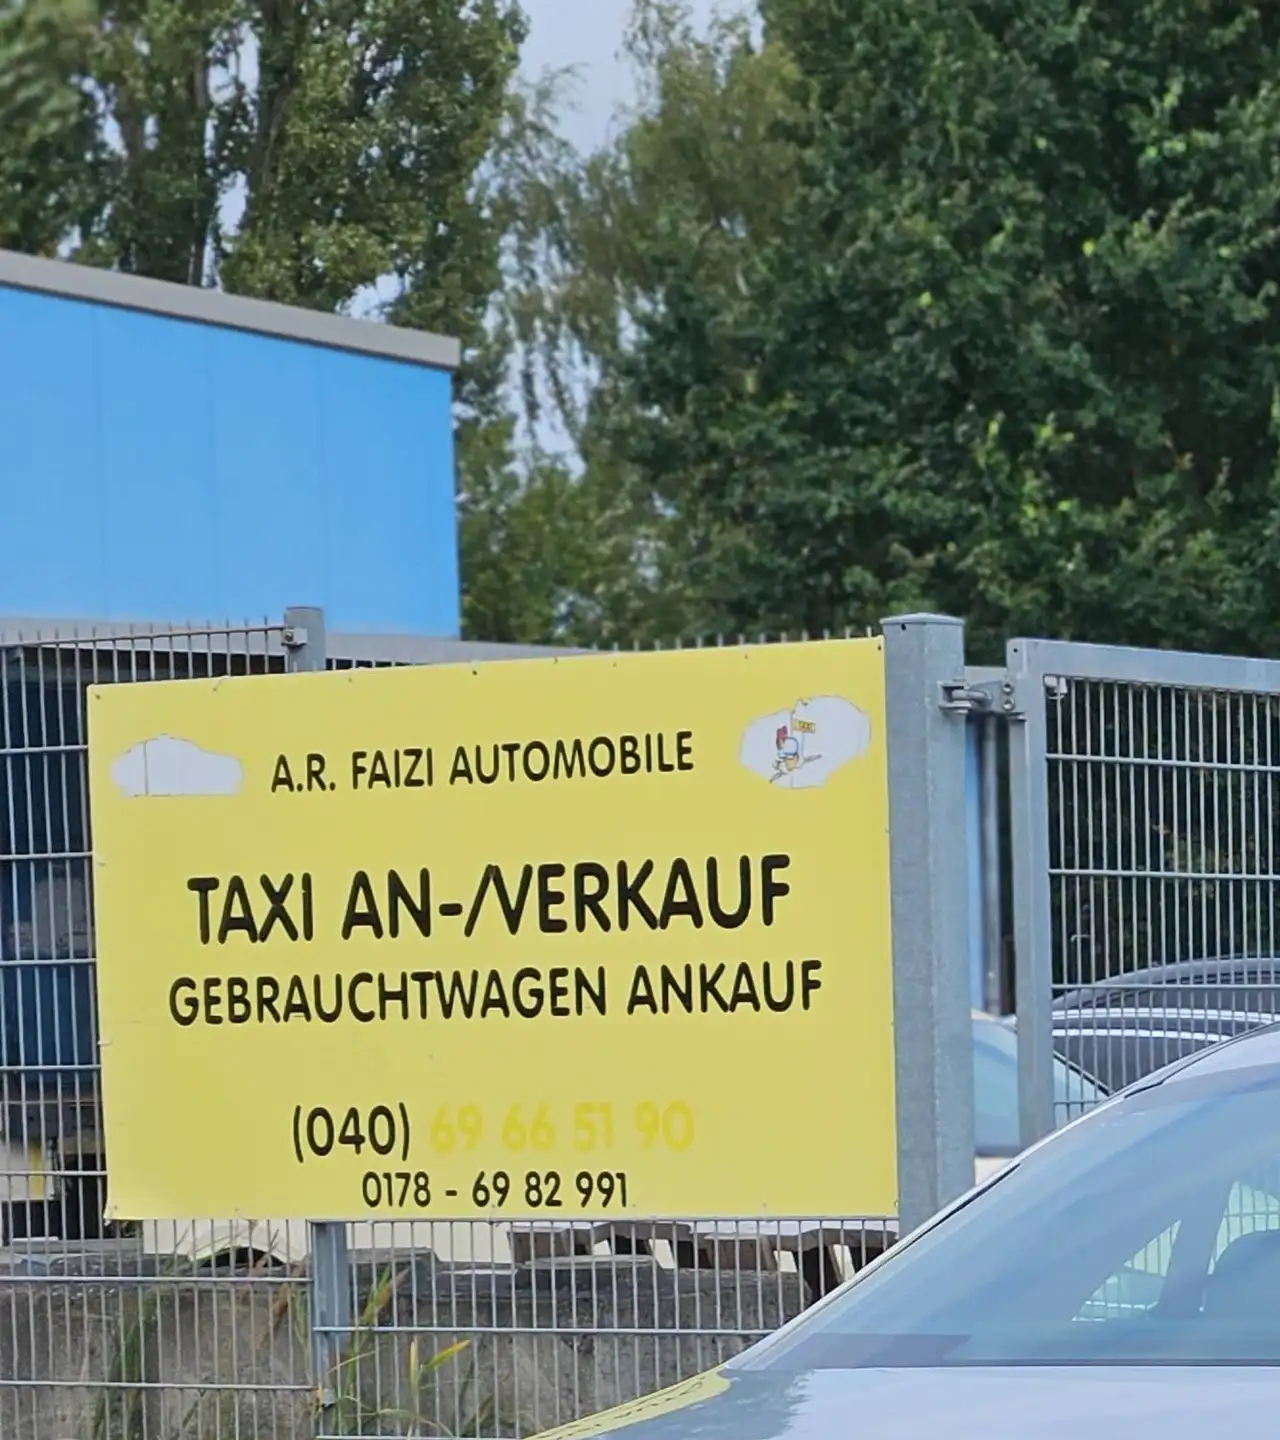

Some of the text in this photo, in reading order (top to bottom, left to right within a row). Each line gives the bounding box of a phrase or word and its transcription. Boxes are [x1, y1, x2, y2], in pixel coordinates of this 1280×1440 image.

[271, 731, 694, 793] A.R. FAIZI AUTOMOBILE
[187, 872, 314, 946] TAXI
[169, 959, 822, 1026] GEBRAUCHTWAGEN ANKAUF
[292, 1100, 695, 1163] (040) 69 66 51 90
[362, 1171, 431, 1208] 0178
[472, 1171, 510, 1208] 69
[525, 1170, 563, 1208] 82
[575, 1171, 627, 1208] 991
